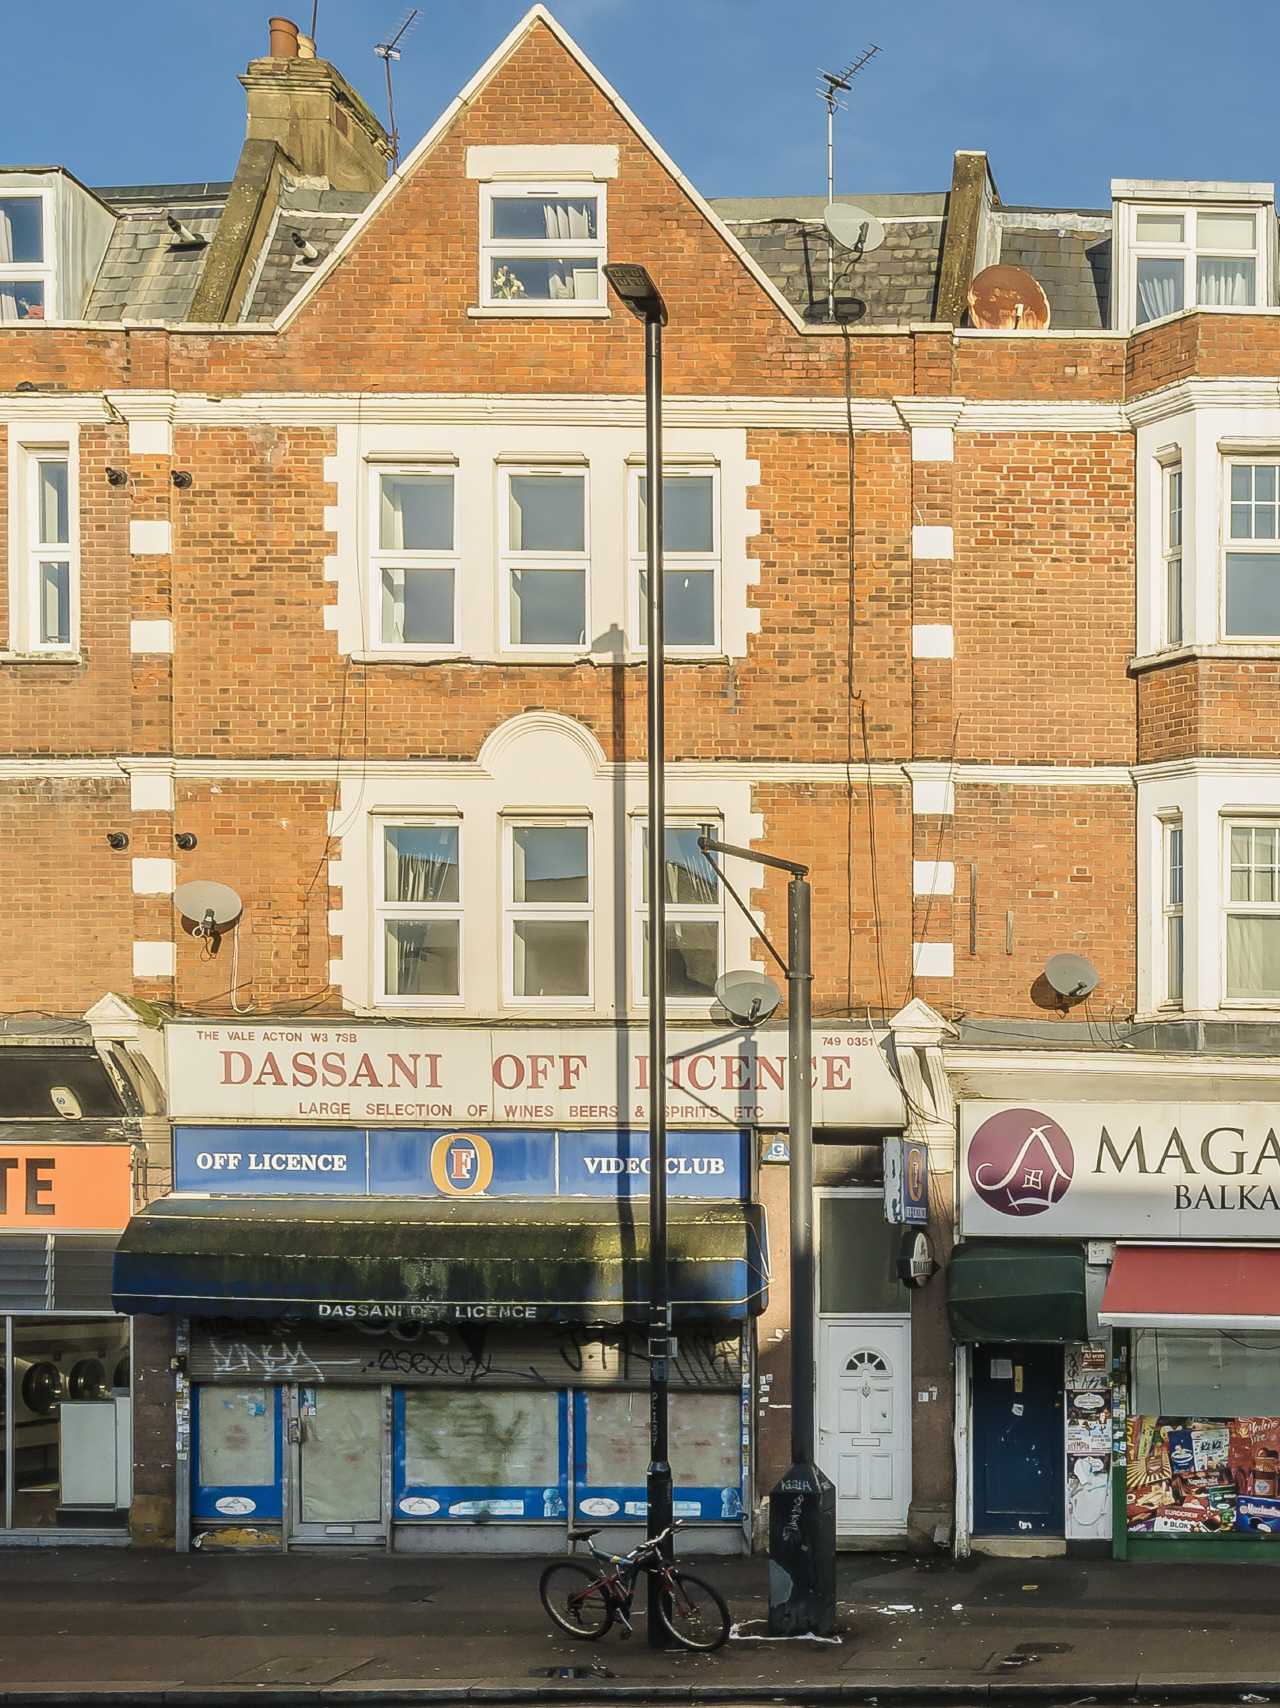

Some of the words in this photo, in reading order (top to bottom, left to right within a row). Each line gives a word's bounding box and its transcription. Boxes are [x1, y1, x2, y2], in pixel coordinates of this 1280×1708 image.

[197, 1030, 220, 1041] THE
[227, 1031, 255, 1041] VALE
[262, 1031, 303, 1042] ACTON
[311, 1032, 329, 1043] W3
[336, 1032, 358, 1043] 7SB
[821, 1036, 841, 1047] 749
[219, 1050, 443, 1090] DASSANI
[492, 1053, 587, 1090] OFF
[299, 1101, 350, 1115] LARGE
[366, 1102, 453, 1117] SELECTION
[467, 1103, 488, 1117] OF
[504, 1103, 554, 1118] WINES
[569, 1103, 618, 1118] BEERS
[634, 1104, 645, 1118] &
[734, 1105, 764, 1119] ETC
[196, 1153, 242, 1171] OFF
[248, 1153, 348, 1171] LICENCE
[664, 1157, 725, 1175] CLUB
[319, 1304, 403, 1317] DASSANI
[455, 1305, 537, 1319] LICENCE
